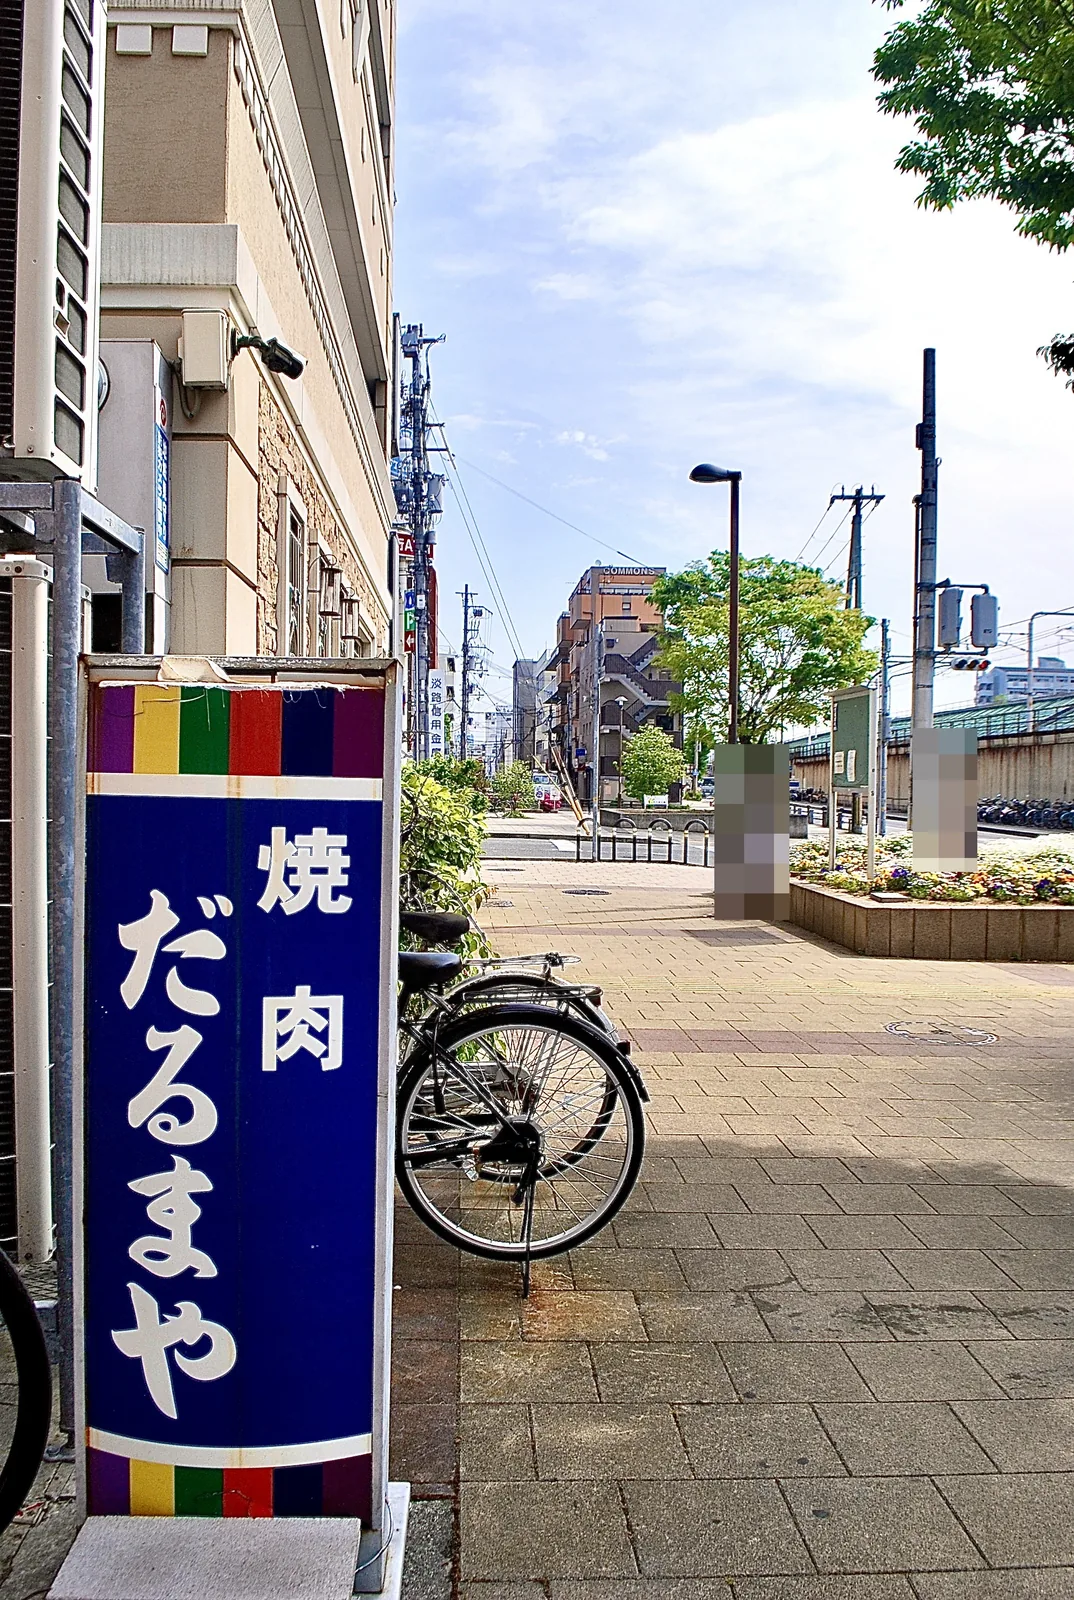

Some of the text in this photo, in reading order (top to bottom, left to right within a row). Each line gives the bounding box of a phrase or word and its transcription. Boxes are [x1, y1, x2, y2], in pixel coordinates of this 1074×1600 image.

[604, 567, 655, 575] COMMONS
[257, 827, 352, 1071] 焼肉
[111, 889, 236, 1419] だるまや
